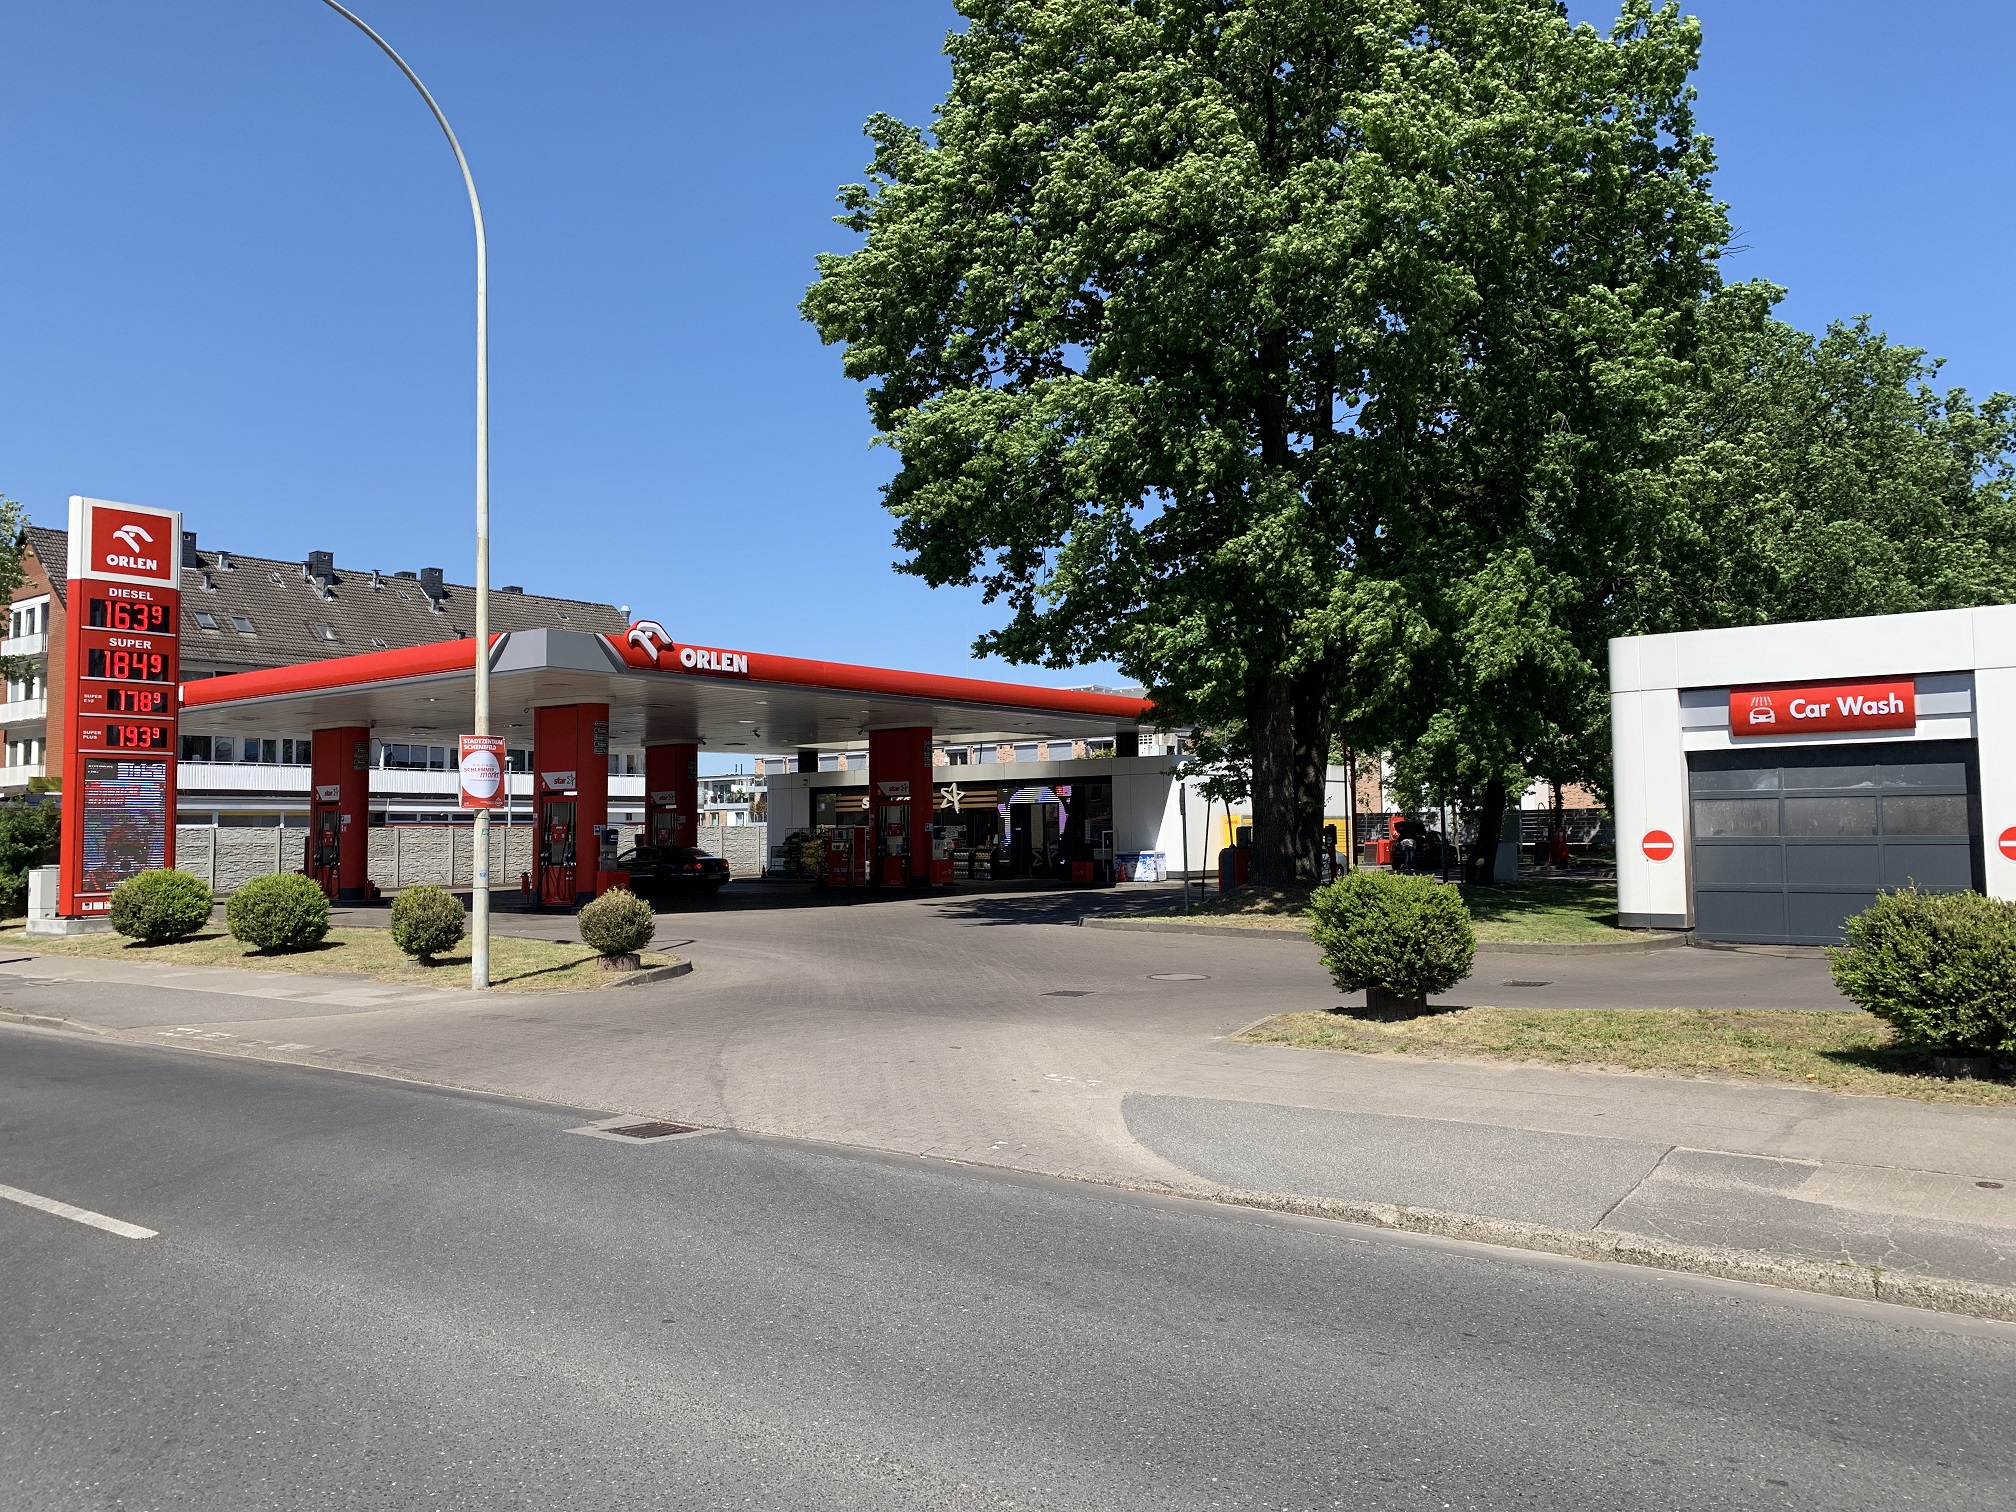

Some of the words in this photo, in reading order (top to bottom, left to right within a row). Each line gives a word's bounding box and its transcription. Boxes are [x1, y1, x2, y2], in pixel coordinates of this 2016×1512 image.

[106, 554, 157, 571] ORLEN
[109, 588, 154, 600] DIESEL
[109, 637, 152, 649] SUPER
[680, 647, 748, 674] ORLEN
[1789, 698, 1830, 720] Car
[1836, 692, 1904, 717] Wash
[553, 776, 567, 785] star
